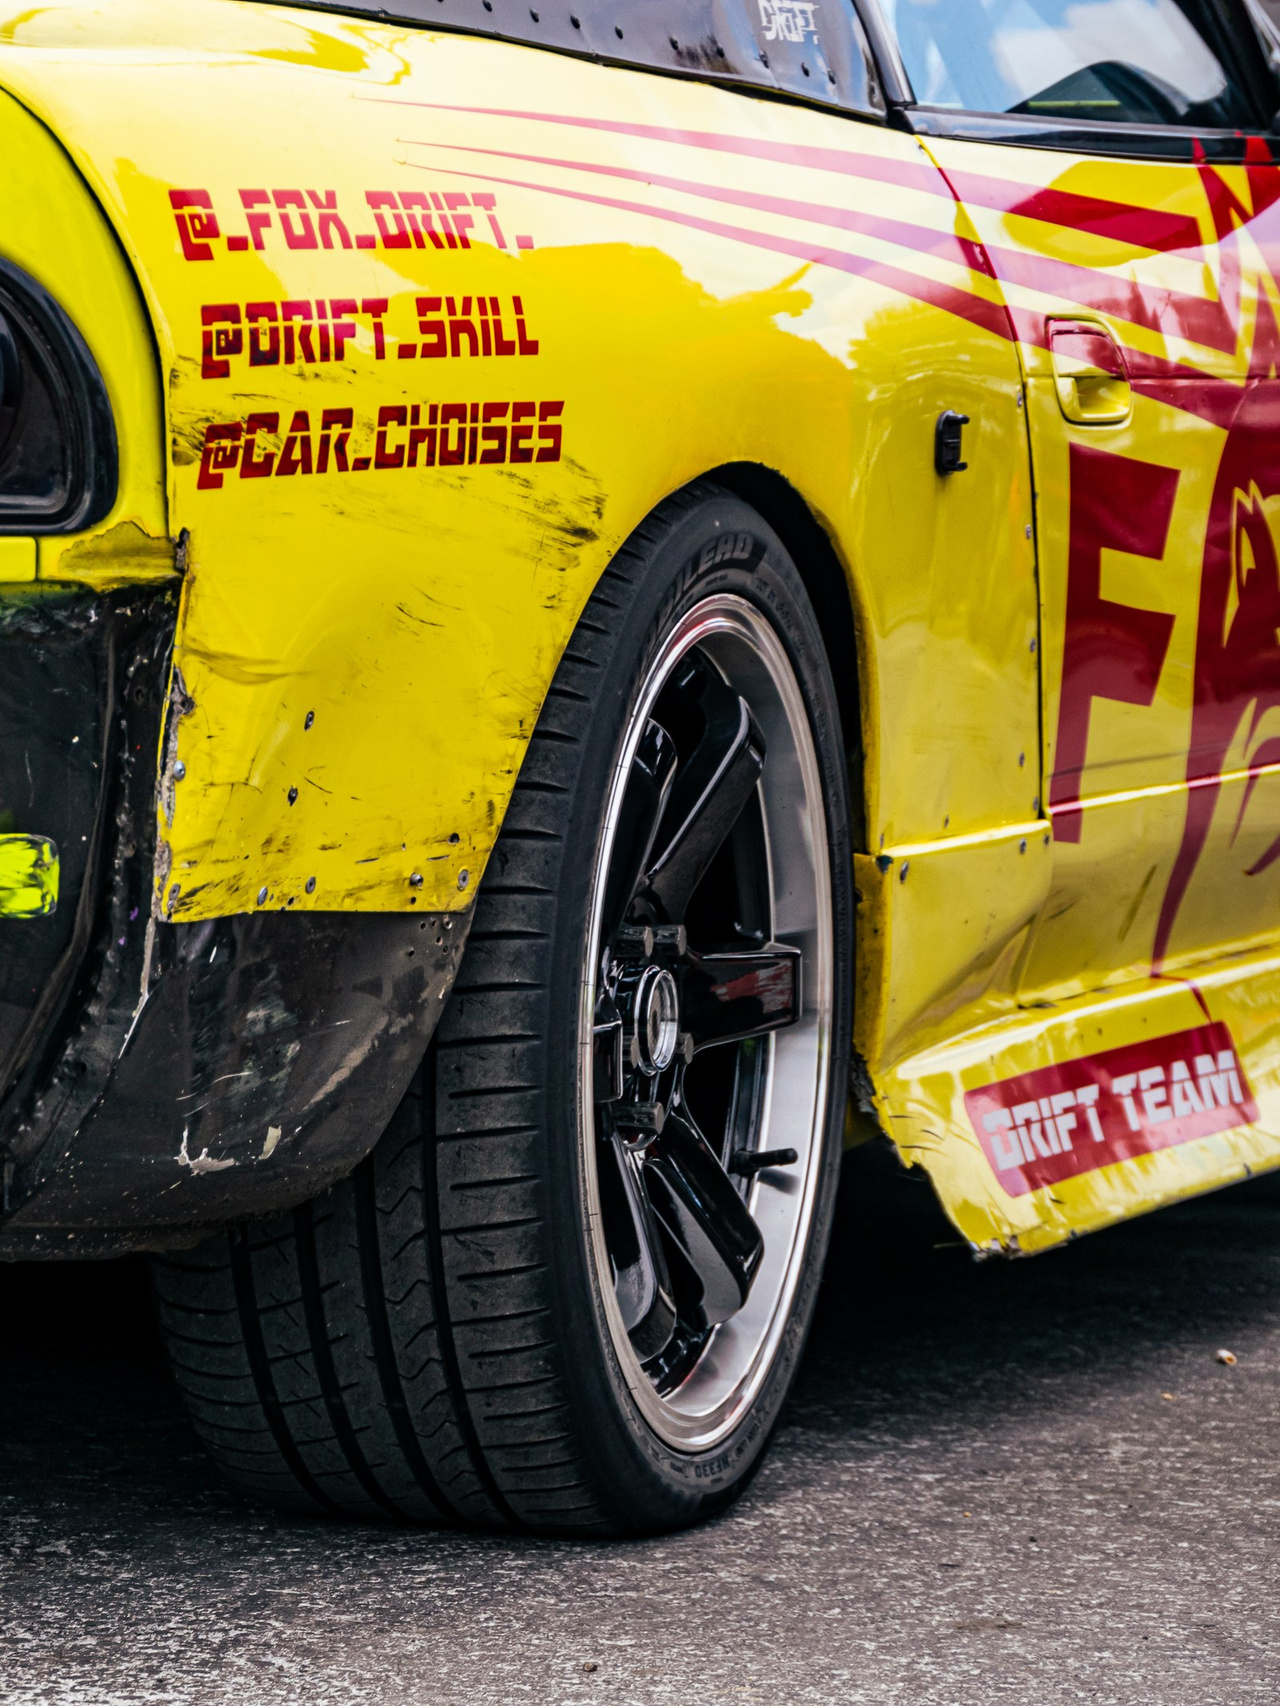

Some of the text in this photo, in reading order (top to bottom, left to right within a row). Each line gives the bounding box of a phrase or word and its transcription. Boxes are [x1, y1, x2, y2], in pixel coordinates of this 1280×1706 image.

[200, 295, 539, 379] @DRIFT_SKILL
[196, 400, 565, 490] @CAR_CHOISES
[982, 1049, 1244, 1171] DRIFT TEAM
